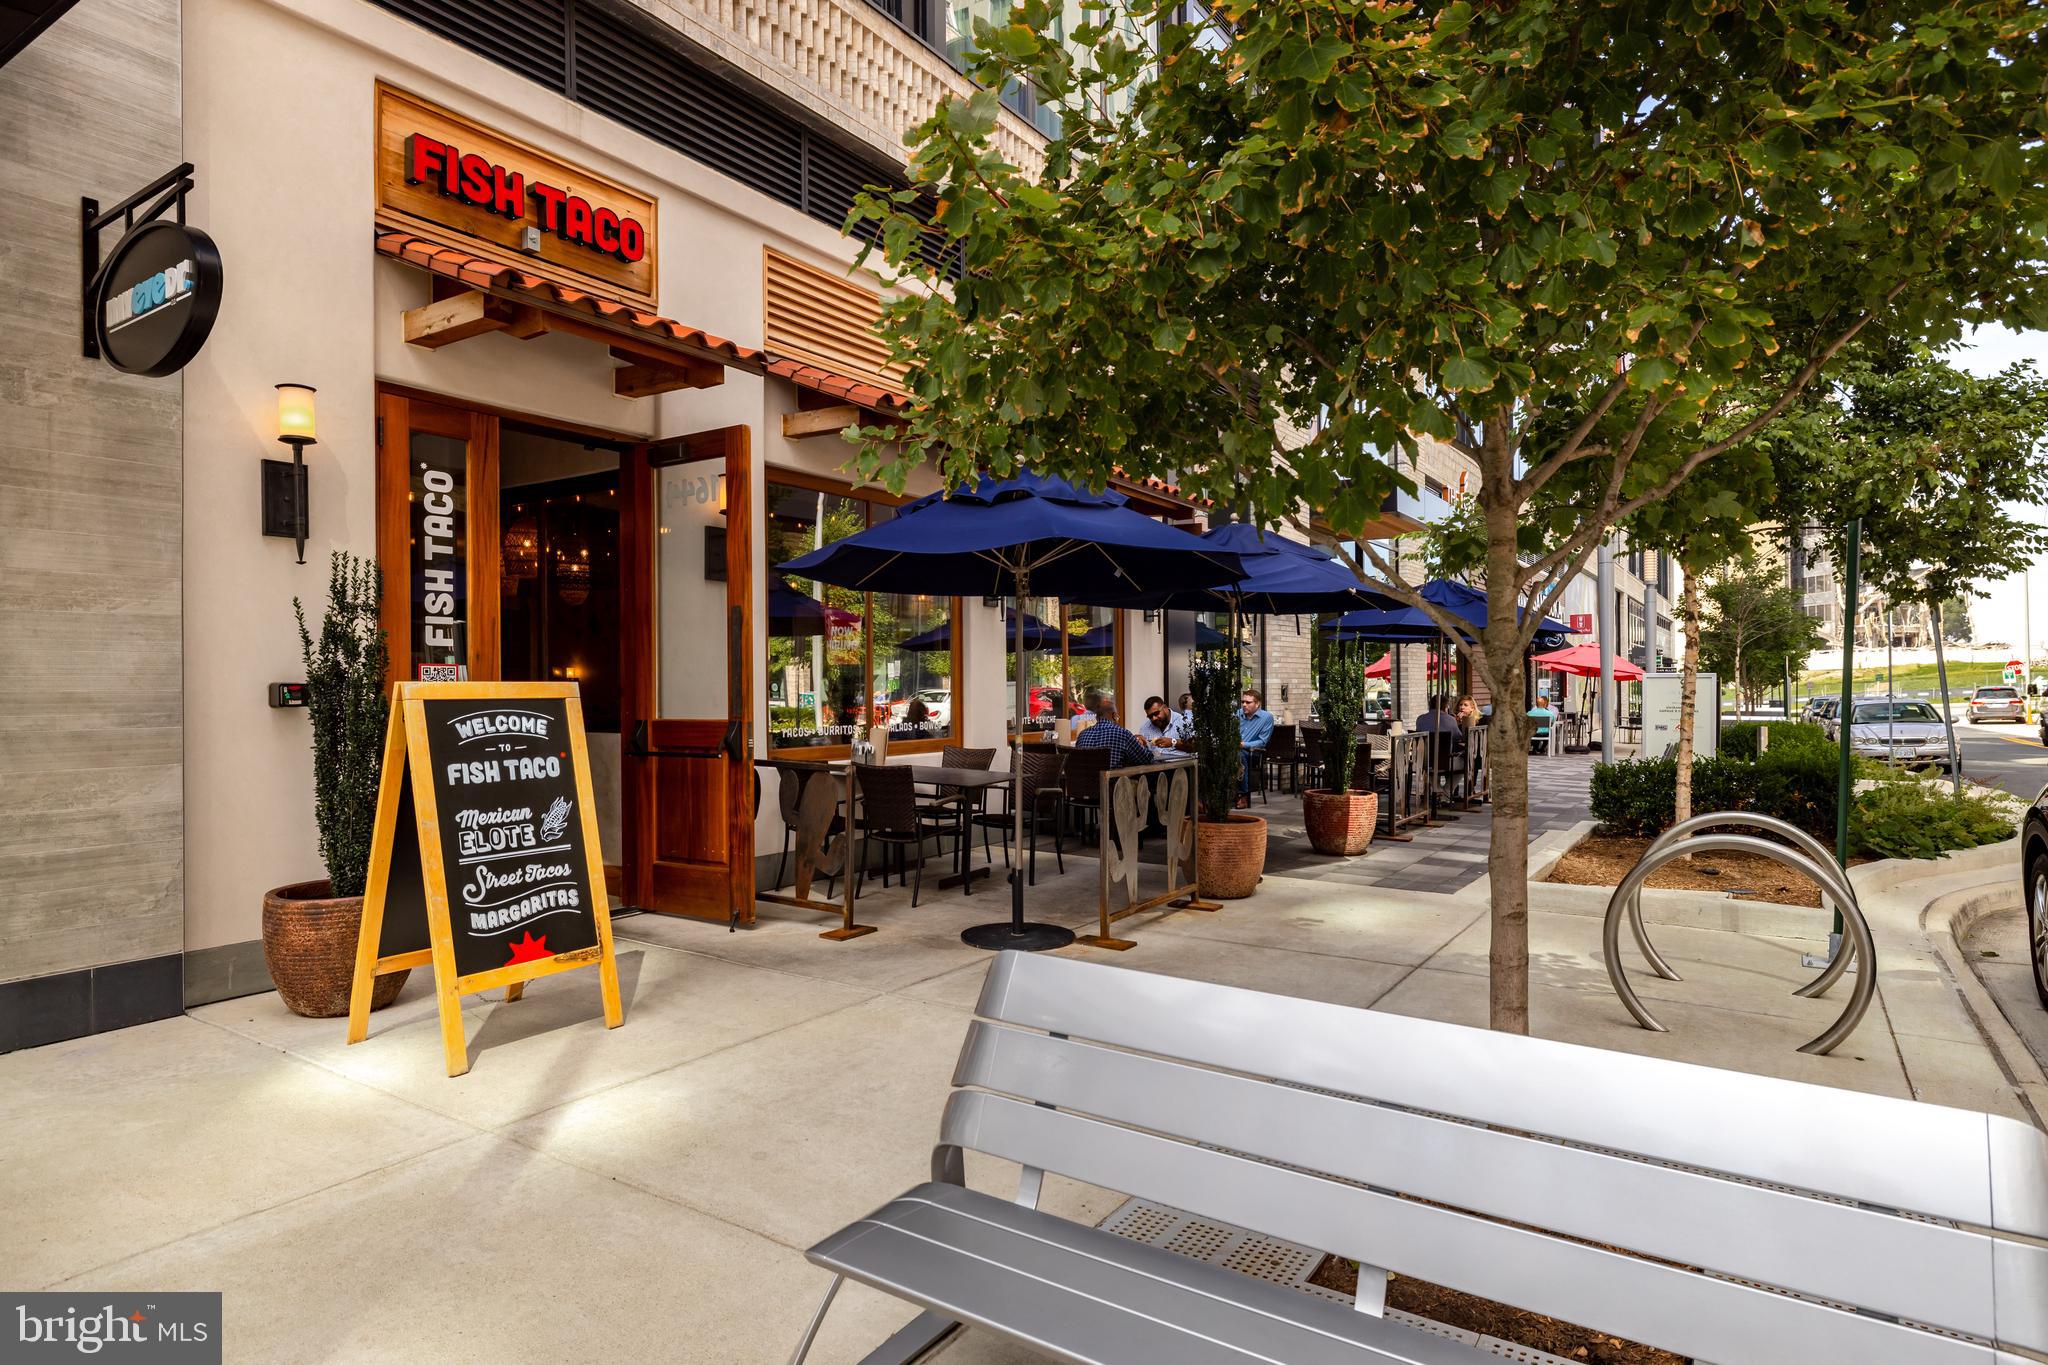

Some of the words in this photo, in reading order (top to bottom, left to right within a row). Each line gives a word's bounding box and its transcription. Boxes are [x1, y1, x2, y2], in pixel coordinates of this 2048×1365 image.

[405, 132, 525, 220] FISH
[526, 181, 645, 264] TACO
[423, 469, 454, 561] TACO
[424, 569, 454, 648] FISH
[831, 626, 853, 637] NOW
[455, 715, 548, 739] WELCOME
[782, 728, 811, 738] TACOS
[498, 743, 511, 752] TO
[447, 760, 501, 786] FISH
[503, 756, 561, 781] TACO
[455, 807, 533, 829] Mexican
[458, 823, 537, 855] ELOTE
[462, 864, 524, 903] Street
[524, 863, 572, 883] Tacos
[470, 888, 580, 930] MARGARITAS
